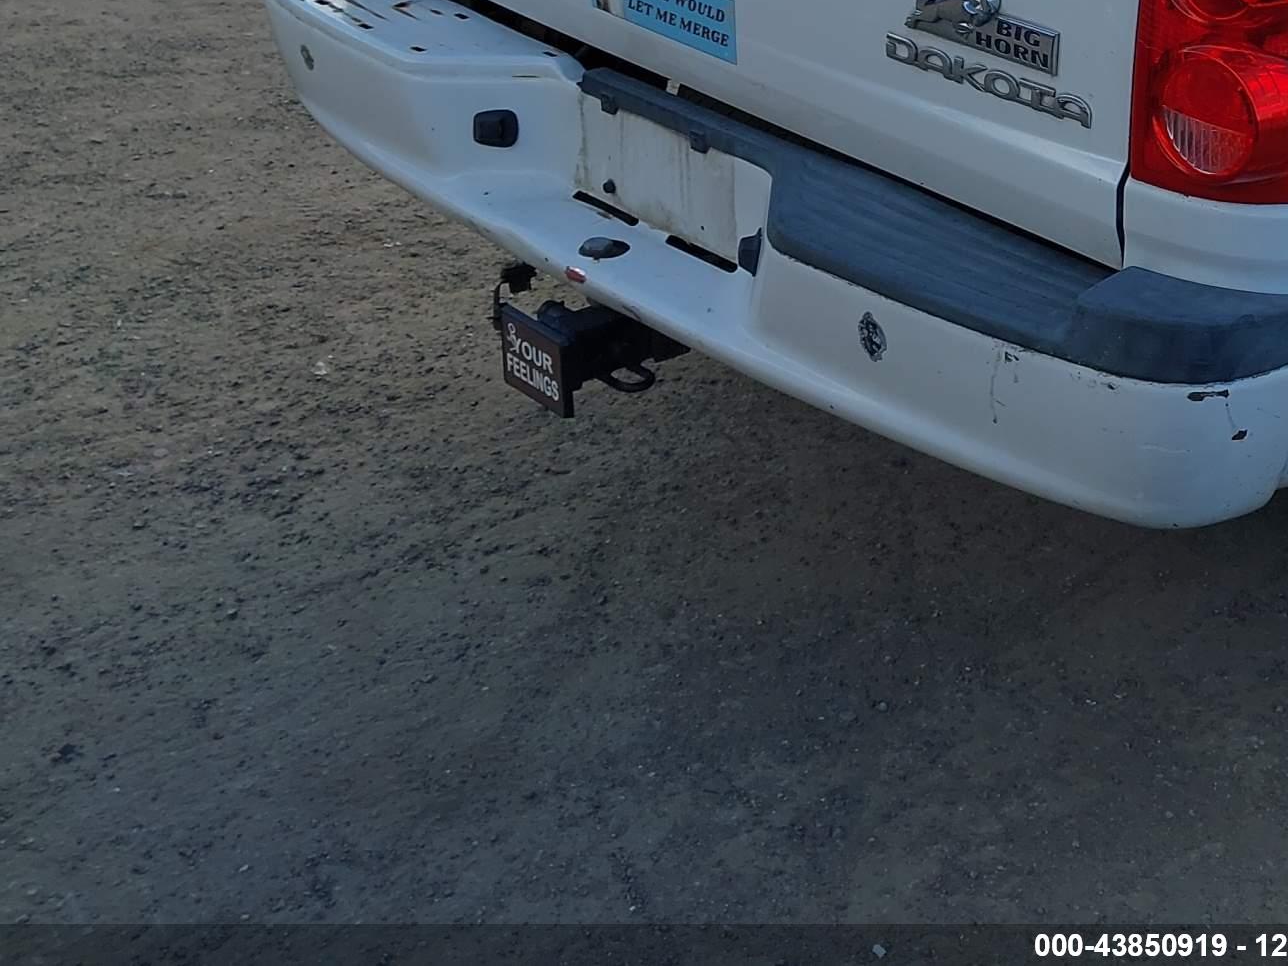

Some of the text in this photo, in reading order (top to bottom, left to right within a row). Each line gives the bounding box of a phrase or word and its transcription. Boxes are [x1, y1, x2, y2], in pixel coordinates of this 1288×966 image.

[655, 6, 677, 27] ME
[679, 16, 730, 48] MERGE
[996, 17, 1041, 47] BIG
[975, 31, 1049, 70] HORN
[885, 31, 1093, 130] DAKOTA
[511, 337, 554, 375] YOUR
[506, 352, 560, 402] FEELINGS
